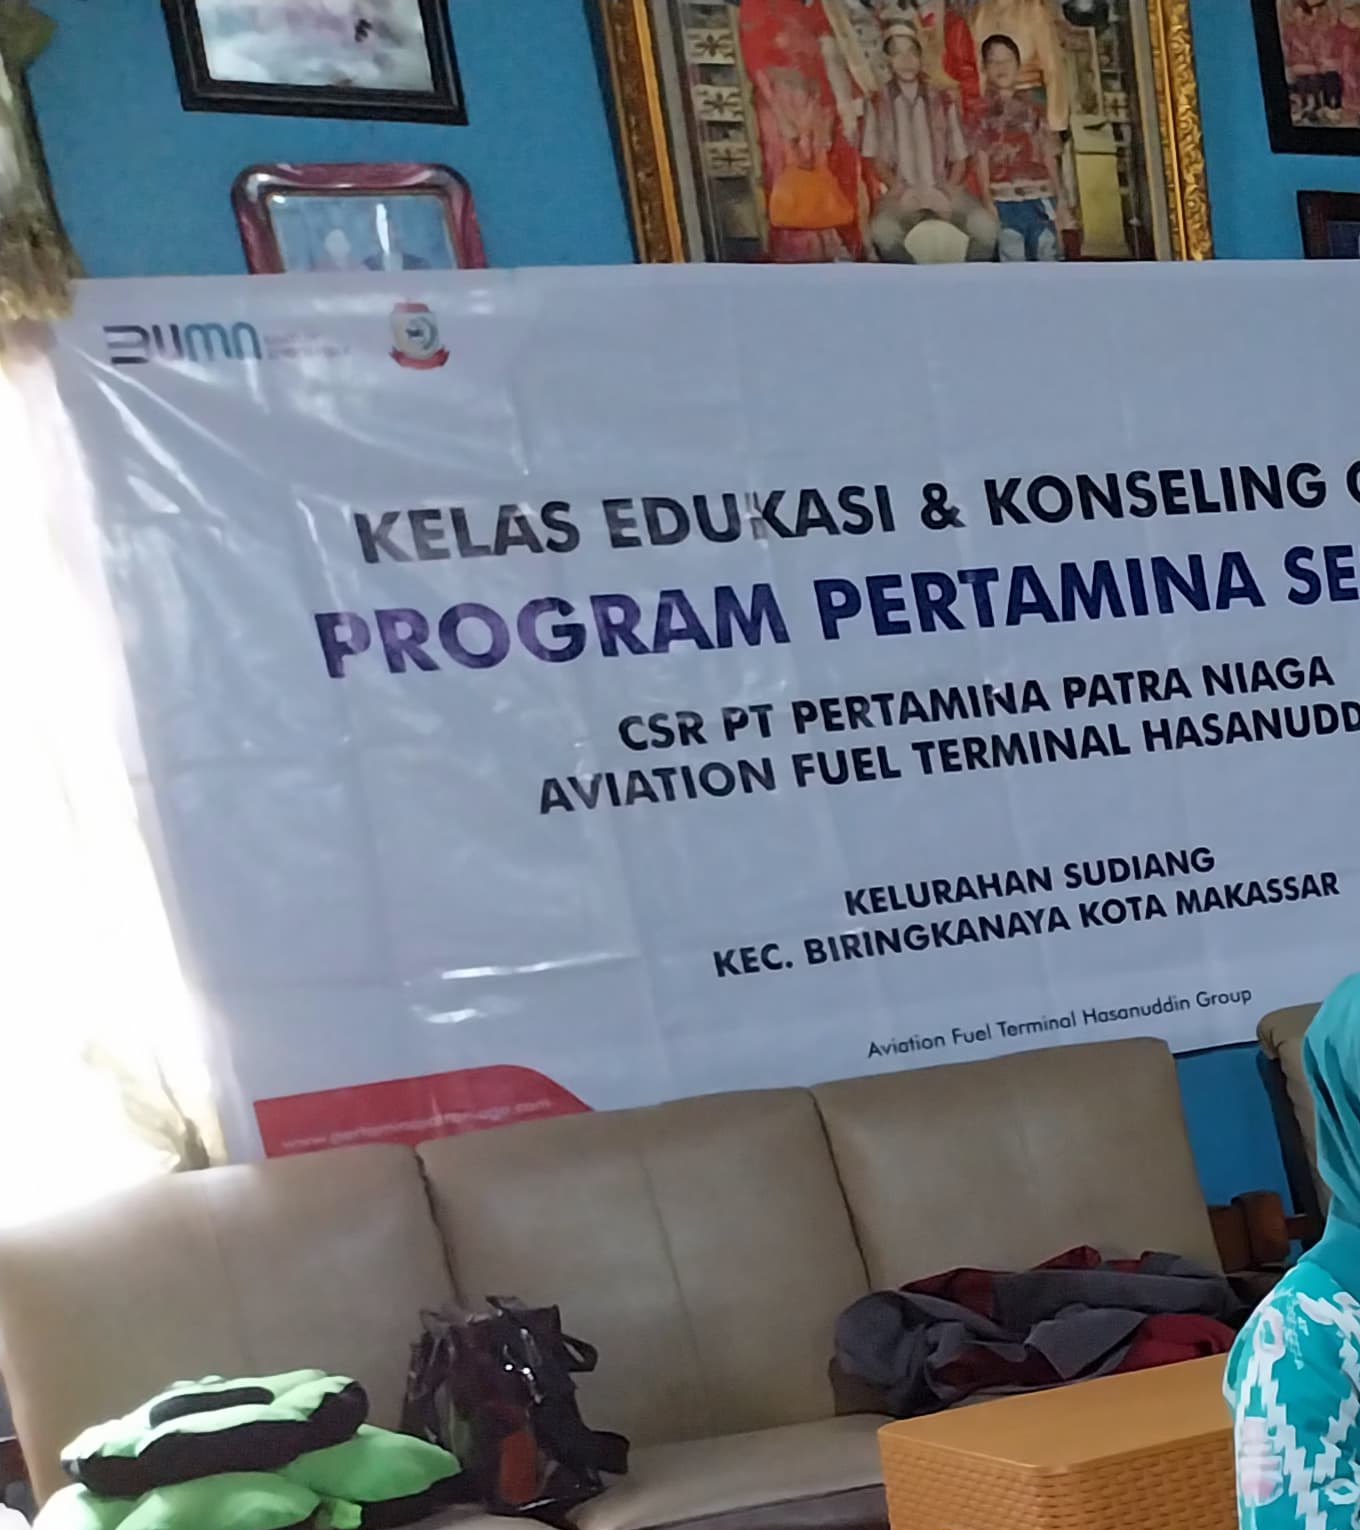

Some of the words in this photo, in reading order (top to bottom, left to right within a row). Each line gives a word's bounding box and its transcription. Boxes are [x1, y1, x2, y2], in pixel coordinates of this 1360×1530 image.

[353, 501, 580, 564] KELAS
[601, 485, 895, 549] EDUKASI
[921, 483, 966, 530] &
[984, 463, 1326, 526] KONSELING
[314, 583, 791, 679] PROGRAM
[813, 551, 1266, 640] PERTAMINA
[618, 711, 708, 751] CSR
[721, 704, 773, 741] PT
[791, 680, 1051, 734] PERTAMINA
[1063, 668, 1192, 709] PATRA
[1202, 656, 1335, 696] NIAGA
[540, 757, 776, 815] AVIATION
[792, 746, 902, 787] FUEL
[911, 723, 1131, 775] TERMINAL
[713, 943, 793, 977] KEC.
[804, 906, 1071, 965] BIRINGKANAYA
[1079, 894, 1167, 928] KOTA
[1176, 872, 1340, 916] MAKASSAR
[844, 866, 1052, 916] KELURAHAN
[1064, 847, 1215, 889] SUDIANG
[867, 1034, 946, 1059] Aviation
[952, 1023, 992, 1045] Fuel
[995, 1010, 1076, 1037] Terminal
[1082, 995, 1190, 1025] Hasanuddin
[1196, 990, 1252, 1007] Group
